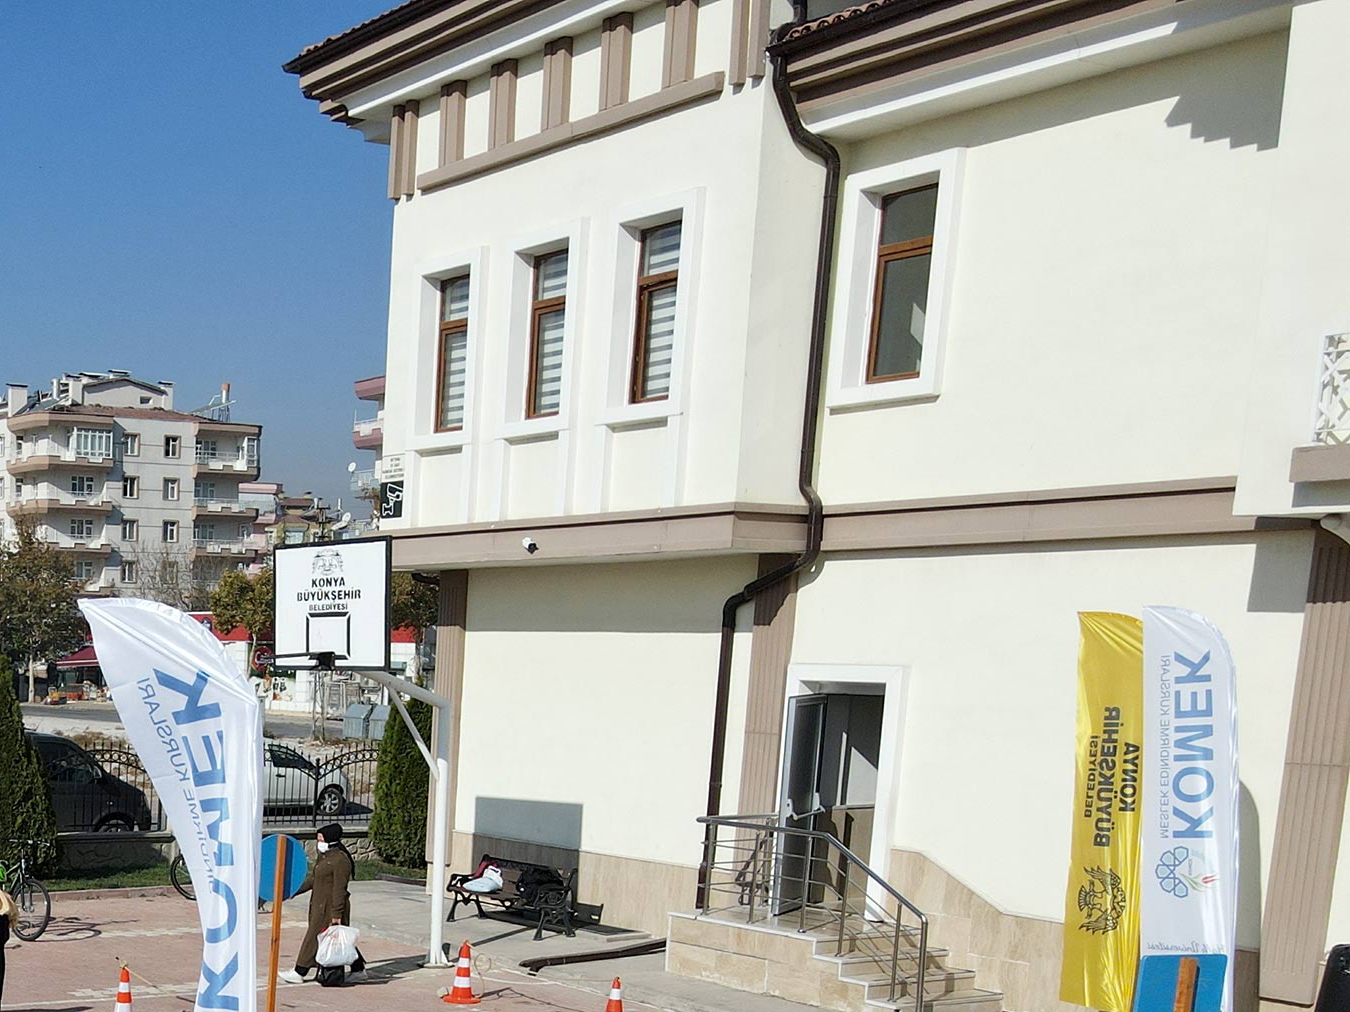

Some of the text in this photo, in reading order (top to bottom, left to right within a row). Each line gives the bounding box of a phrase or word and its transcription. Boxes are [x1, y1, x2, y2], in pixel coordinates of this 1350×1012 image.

[311, 576, 346, 588] KONYA
[296, 587, 361, 602] BÜYÜKŞEHİR
[308, 601, 348, 611] BELEDİYESİ
